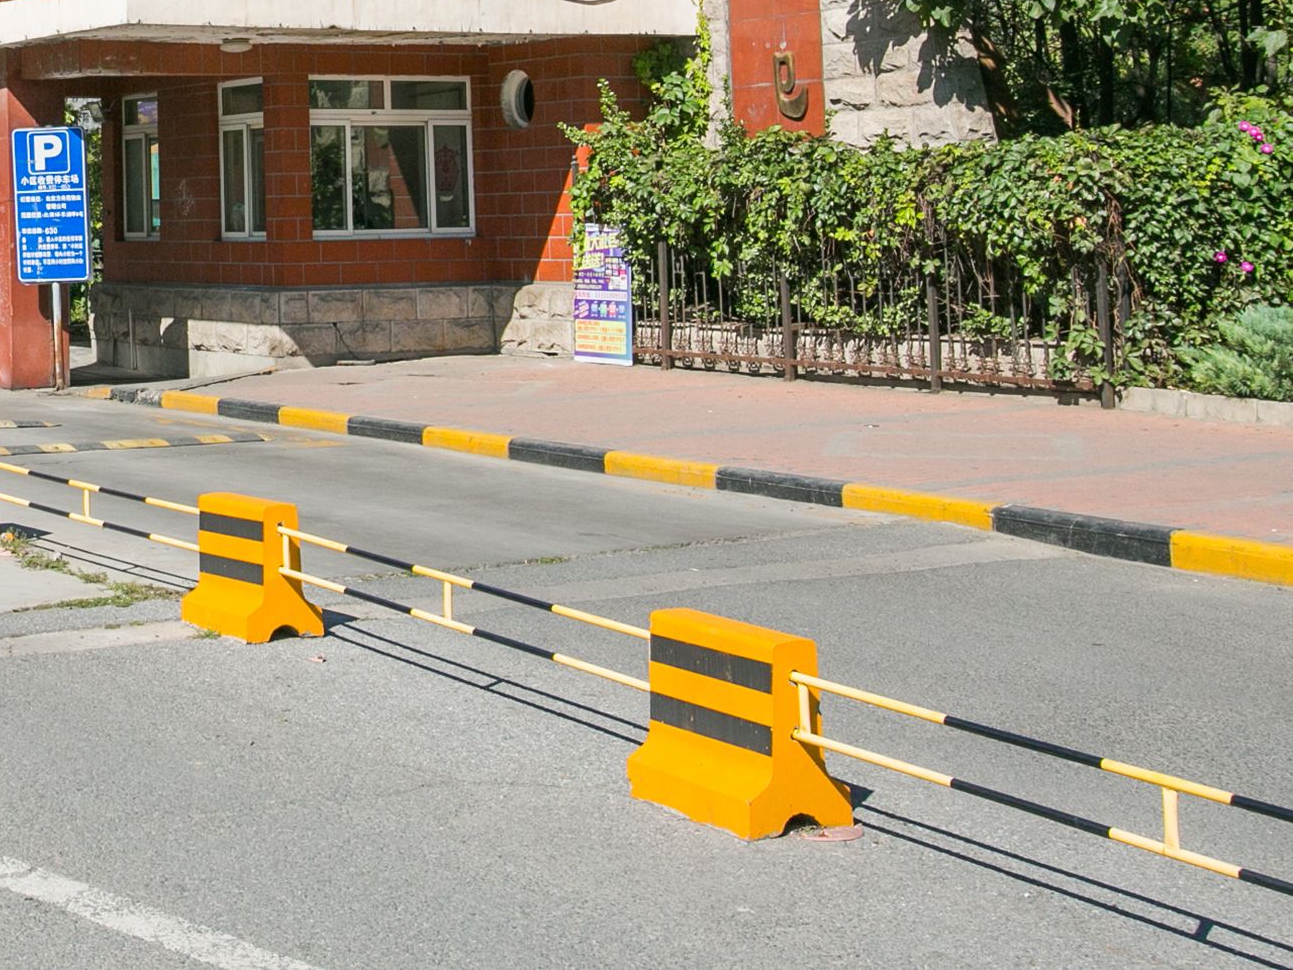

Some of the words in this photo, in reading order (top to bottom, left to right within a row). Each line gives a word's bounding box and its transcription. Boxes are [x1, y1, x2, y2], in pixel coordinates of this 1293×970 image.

[33, 134, 63, 171] P
[20, 174, 79, 186] 小区收费停车场
